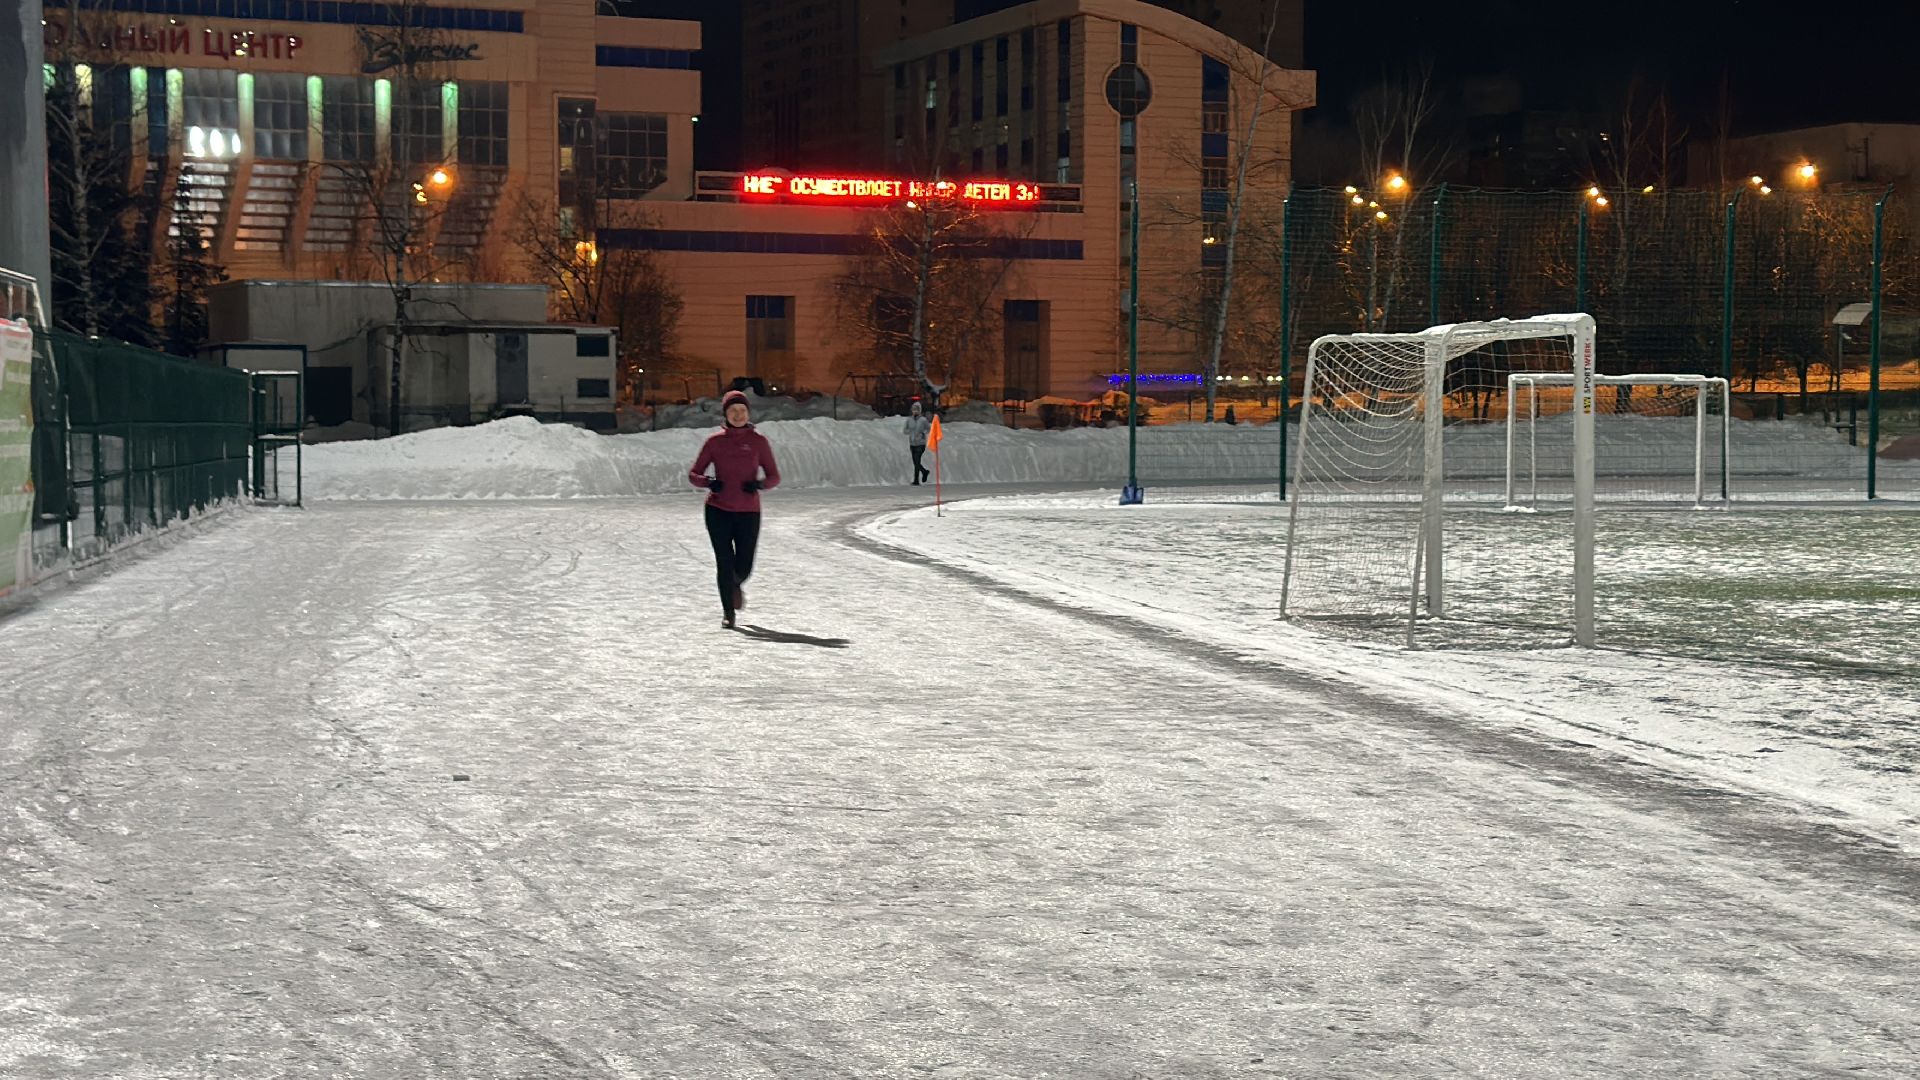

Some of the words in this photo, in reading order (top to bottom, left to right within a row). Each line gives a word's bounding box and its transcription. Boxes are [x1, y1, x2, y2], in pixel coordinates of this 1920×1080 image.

[203, 29, 303, 60] ЦЕНТР
[790, 177, 903, 196] ОСУЩЕСТВЛЯЕТ
[963, 182, 1009, 201] ДЕТЕЙ
